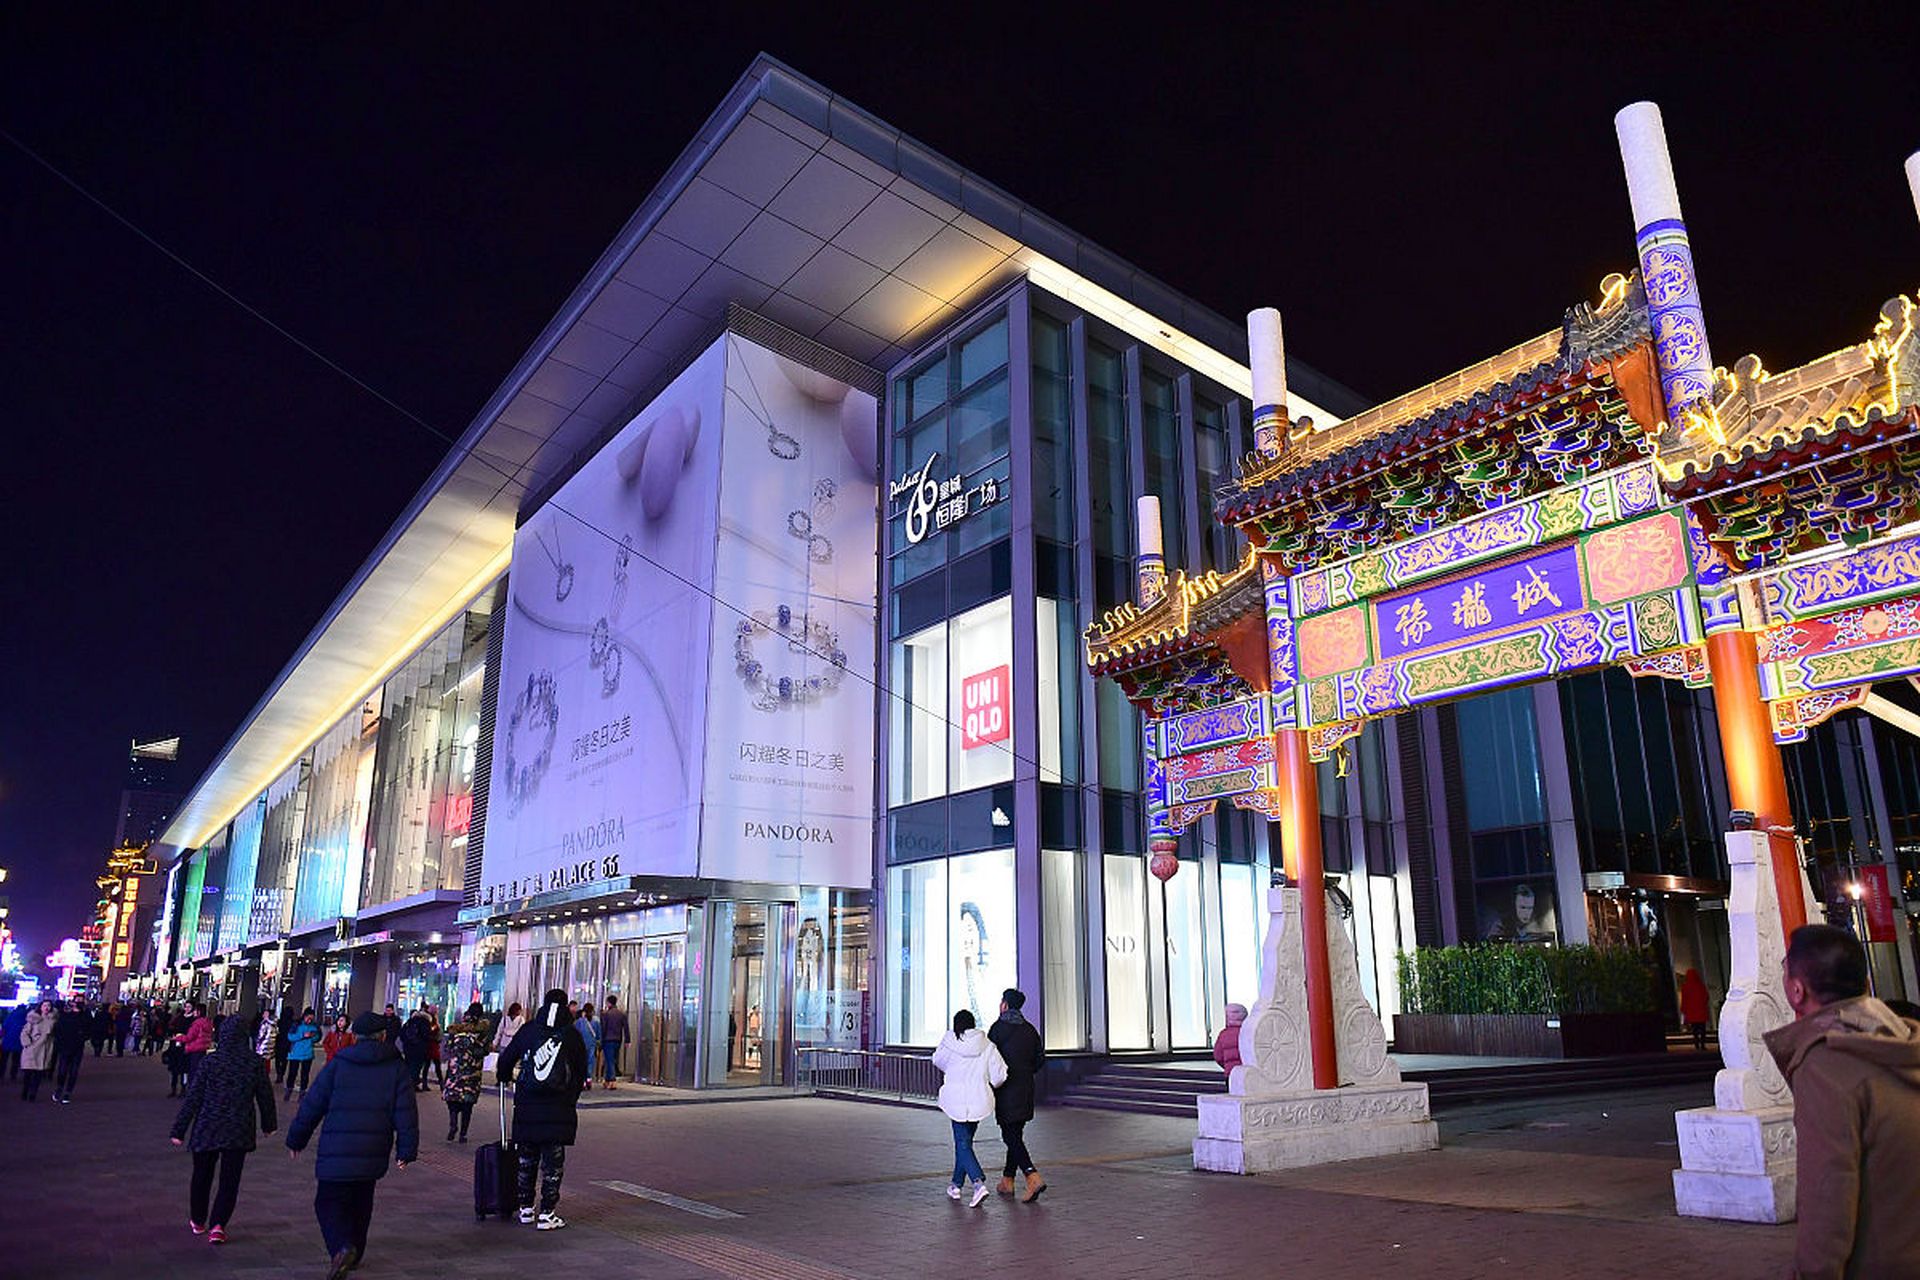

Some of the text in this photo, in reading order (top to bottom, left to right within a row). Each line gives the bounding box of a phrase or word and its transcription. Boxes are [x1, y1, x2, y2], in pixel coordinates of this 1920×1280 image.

[936, 478, 997, 529] 恒隆广场
[966, 676, 999, 710] UNI
[570, 713, 631, 762] 闪耀冬日之美
[966, 706, 1002, 742] QLO
[740, 742, 844, 772] 闪耀冬日之美
[561, 814, 626, 858] PANDORA
[744, 821, 834, 844] PANDORA
[550, 860, 596, 891] PALACE
[602, 854, 620, 879] 66
[533, 1037, 557, 1070] NIKE
